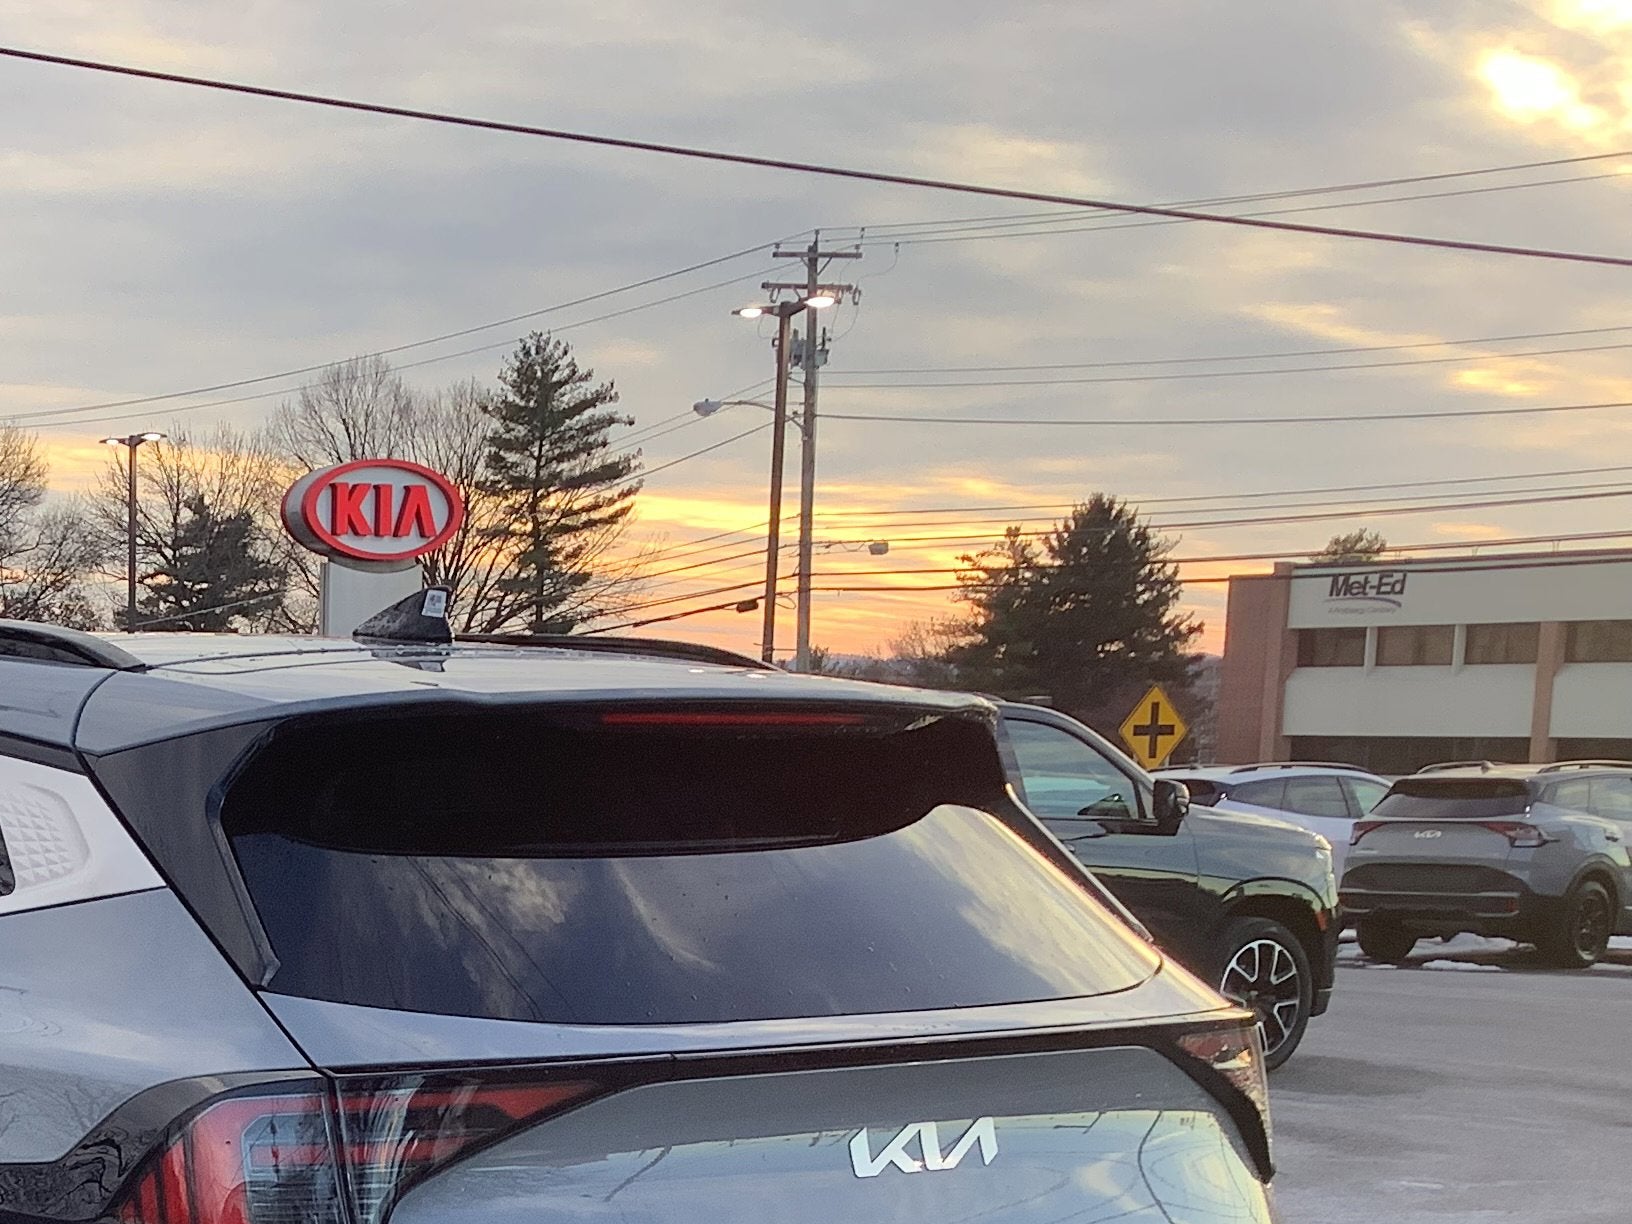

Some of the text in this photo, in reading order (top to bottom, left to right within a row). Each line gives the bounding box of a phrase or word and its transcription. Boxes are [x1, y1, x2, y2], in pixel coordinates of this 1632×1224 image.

[329, 482, 438, 538] KIA
[1328, 571, 1407, 597] Met-Ed
[848, 1115, 999, 1179] KIA
